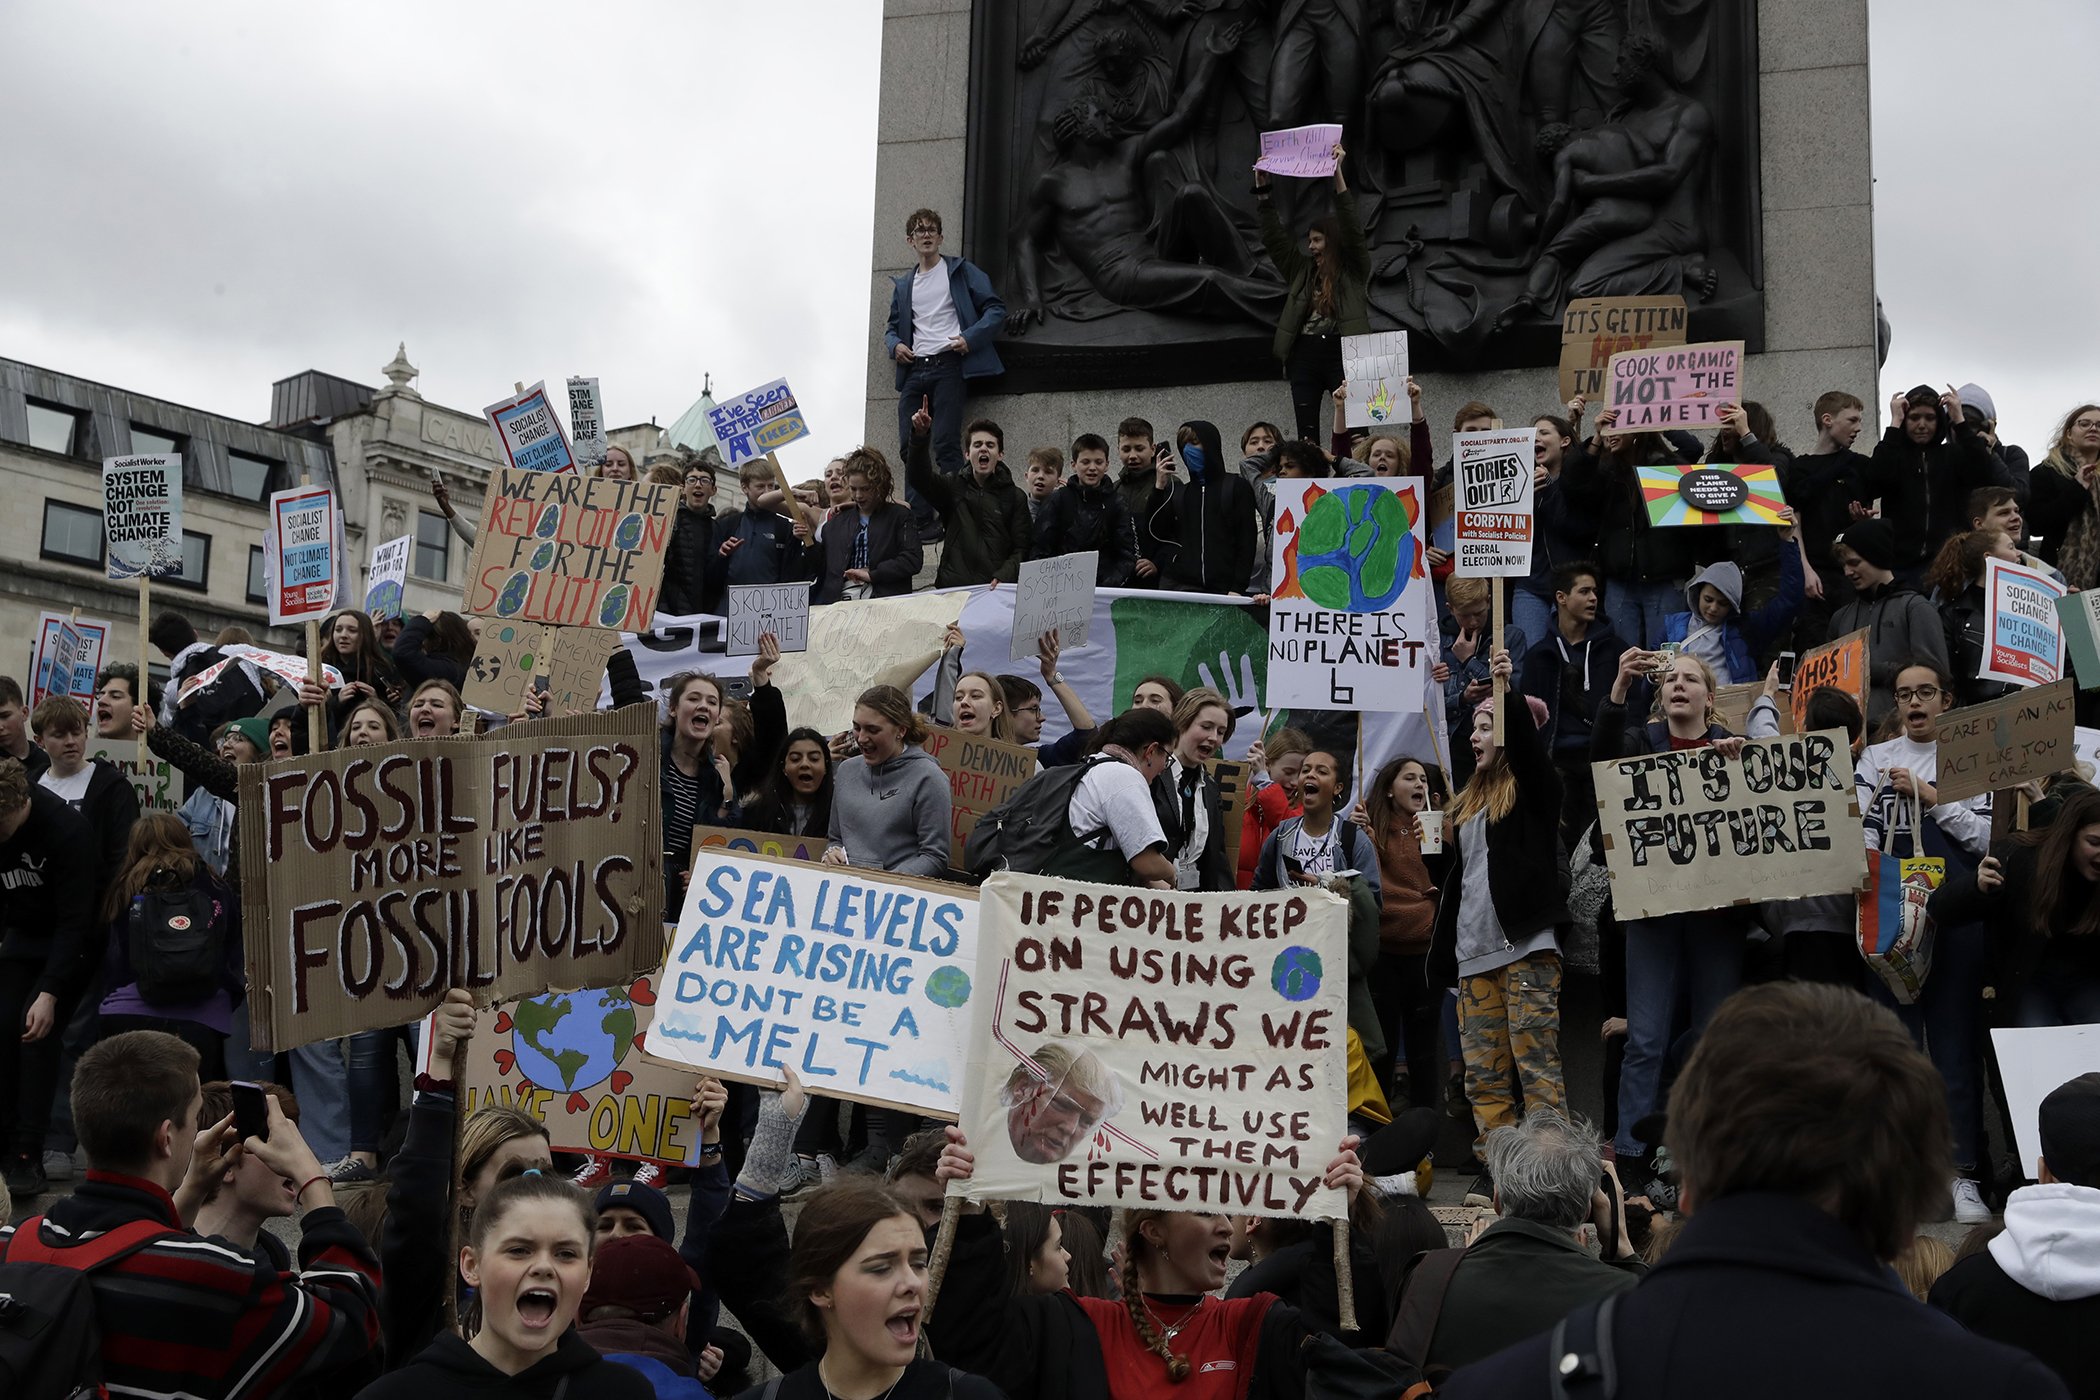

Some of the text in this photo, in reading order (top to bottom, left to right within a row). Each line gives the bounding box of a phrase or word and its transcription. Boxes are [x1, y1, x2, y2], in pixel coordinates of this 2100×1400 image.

[1264, 130, 1299, 150] Earth
[1565, 308, 1684, 334] ITS GETTIN
[1343, 332, 1406, 360] BETTER
[1345, 353, 1407, 382] BELIEVE
[1615, 350, 1734, 378] COOK ORGANIC
[1615, 372, 1734, 405] NOT THE
[710, 385, 790, 426] I've Seen
[1610, 404, 1709, 428] PLANET
[510, 408, 547, 434] SOCIALIST
[518, 422, 550, 446] CHANGE
[715, 411, 762, 441] BETTER
[428, 418, 498, 460] CANA
[515, 437, 563, 468] NOT CLIMATE
[728, 420, 800, 462] AT IKEA
[1461, 436, 1529, 446] SOCIALISTPARTY.ORG.UK
[106, 470, 165, 486] SYSTEM
[1465, 458, 1518, 484] TORIES
[106, 484, 168, 500] CHANGE
[500, 470, 672, 516] WE ARE THE
[1468, 483, 1496, 506] OUT
[107, 500, 134, 514] NOT
[108, 512, 170, 528] CLIMATE
[288, 510, 323, 530] SOCIALIST
[1464, 513, 1512, 528] CORBYN
[1515, 516, 1526, 529] IN
[110, 526, 168, 542] CHANGE
[292, 527, 320, 544] CHANGE
[488, 496, 667, 553] REVOLUTION
[1462, 530, 1526, 540] with Socialist Policies
[284, 547, 329, 567] NOT CLIMATE
[376, 542, 404, 564] WHAT I
[510, 536, 642, 584] FOR THE
[1462, 544, 1500, 554] GENERAL
[1462, 555, 1526, 566] ELECTION NOW!
[294, 564, 321, 581] CHANGE
[370, 558, 403, 580] STAND FOR
[1040, 558, 1074, 574] CHANGE
[284, 590, 298, 600] Young
[474, 566, 655, 631] SOLUTION
[1024, 571, 1083, 601] SYSTEMS
[2007, 586, 2053, 612] SOCIALIST
[285, 597, 305, 608] Socialists
[1043, 596, 1058, 610] NOT
[2011, 600, 2049, 625] CHANGE
[1276, 612, 1408, 640] THERE IS
[1998, 616, 2057, 648] NOT CLIMATE
[485, 623, 609, 666] GOVENMENT
[1270, 636, 1425, 668] NO PLANET
[1995, 648, 2016, 662] Young
[2010, 634, 2047, 657] CHANGE
[503, 649, 594, 690] NO THE
[1997, 656, 2028, 670] Socialists
[503, 675, 594, 712] CLMATE
[1939, 697, 2073, 744] CARE IS AN ACT
[960, 741, 1028, 778] DENYING
[1618, 735, 1844, 812] IT'S OUR
[1942, 754, 1979, 780] ACT
[1986, 747, 2013, 765] LIKE
[943, 768, 996, 802] ARTH
[265, 752, 478, 863] FOSSIL
[491, 742, 639, 832] FUELS?
[1626, 800, 1831, 866] FUTURE
[351, 823, 546, 892] MORE LIKE
[1293, 847, 1316, 857] SAVE
[0, 868, 44, 890] UMA
[698, 865, 963, 957] SEA LEVELS
[1020, 890, 1308, 943] IF PEOPLE KEEP
[290, 854, 634, 1015] FOSSIL FOOLS
[678, 923, 768, 972] ARE
[772, 933, 914, 995] RISING
[1014, 936, 1255, 988] ON USING
[675, 971, 920, 1040] DONT BE A
[1014, 990, 1332, 1051] STRAWS WE
[708, 1014, 889, 1086] MELT
[1140, 1060, 1315, 1092] MIGHT AS
[588, 1094, 693, 1161] ONE
[1140, 1100, 1310, 1140] WELL USE
[1169, 1136, 1299, 1170] THEM
[1058, 1162, 1322, 1214] EFFECTIVLY
